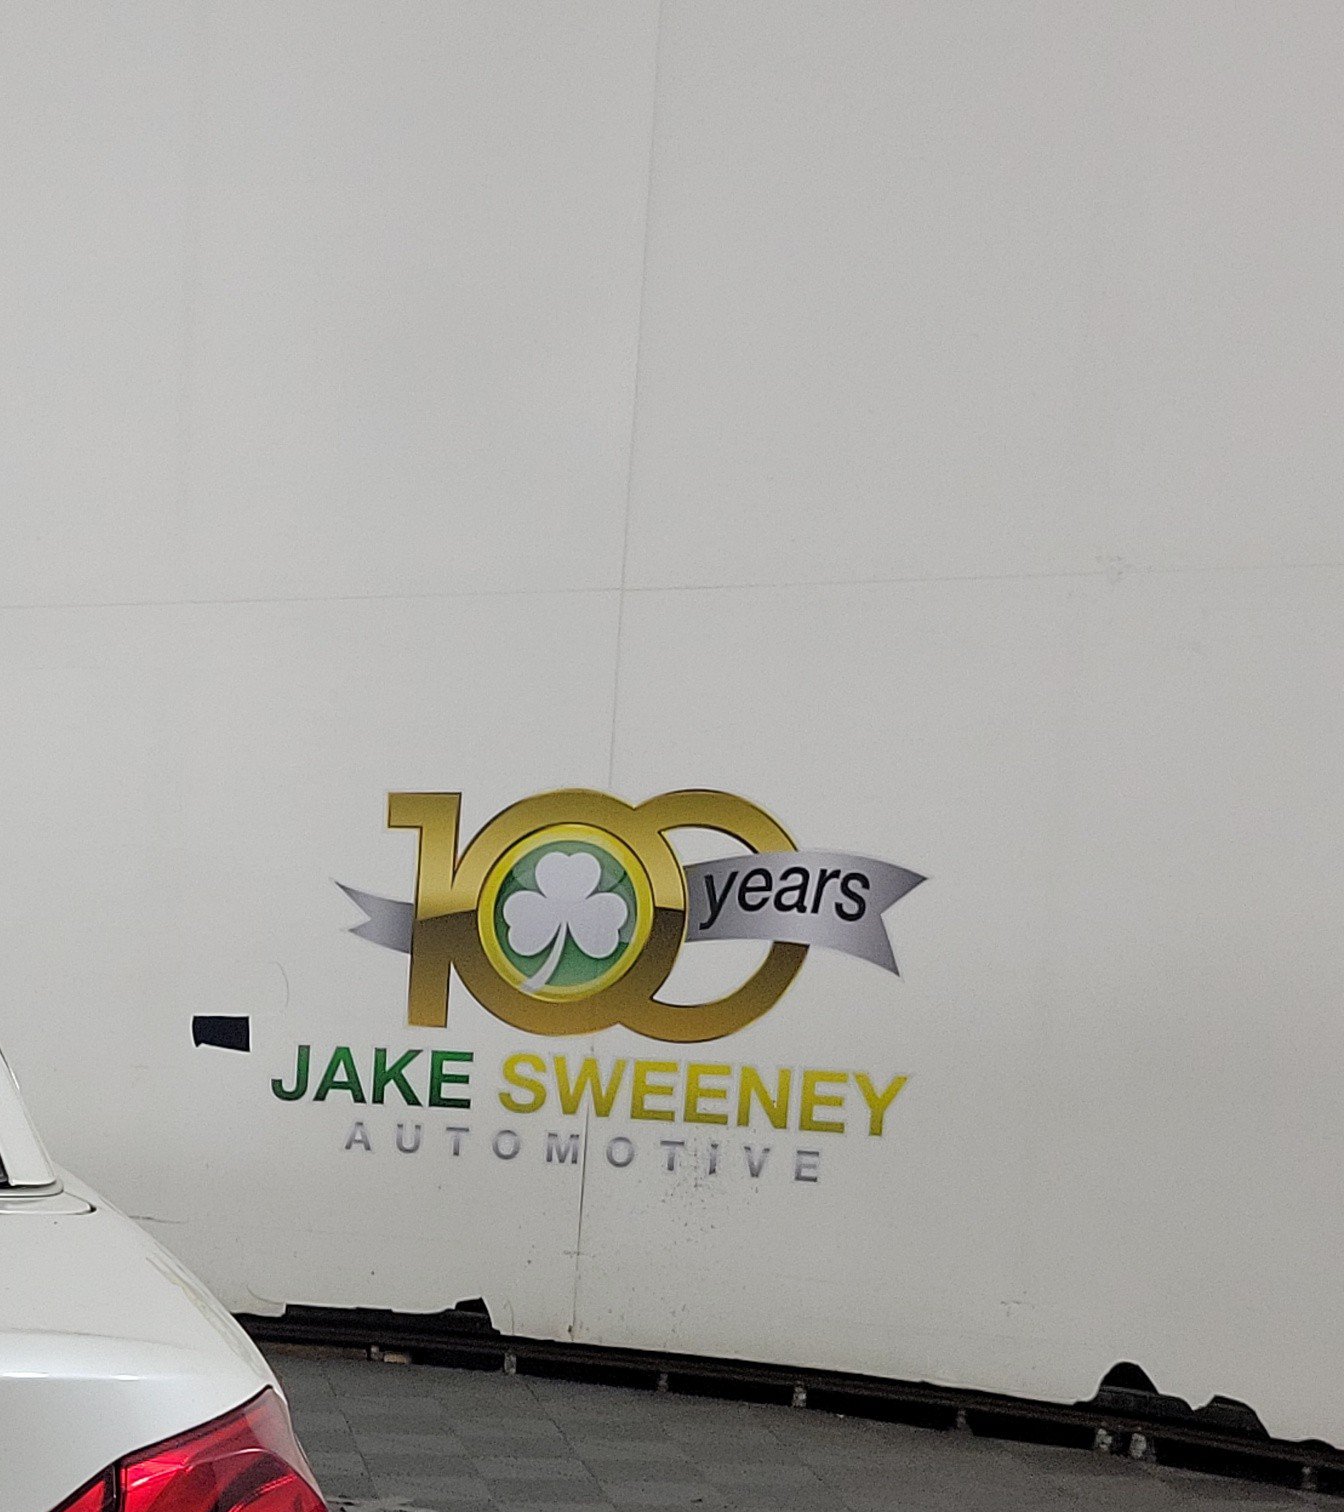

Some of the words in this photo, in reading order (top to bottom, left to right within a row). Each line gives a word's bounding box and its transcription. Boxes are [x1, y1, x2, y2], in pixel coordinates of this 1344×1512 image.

[700, 865, 870, 930] years
[270, 1044, 474, 1109] JAKE
[497, 1052, 909, 1137] SWEENEY
[344, 1120, 822, 1183] AUTOMOTIVE
